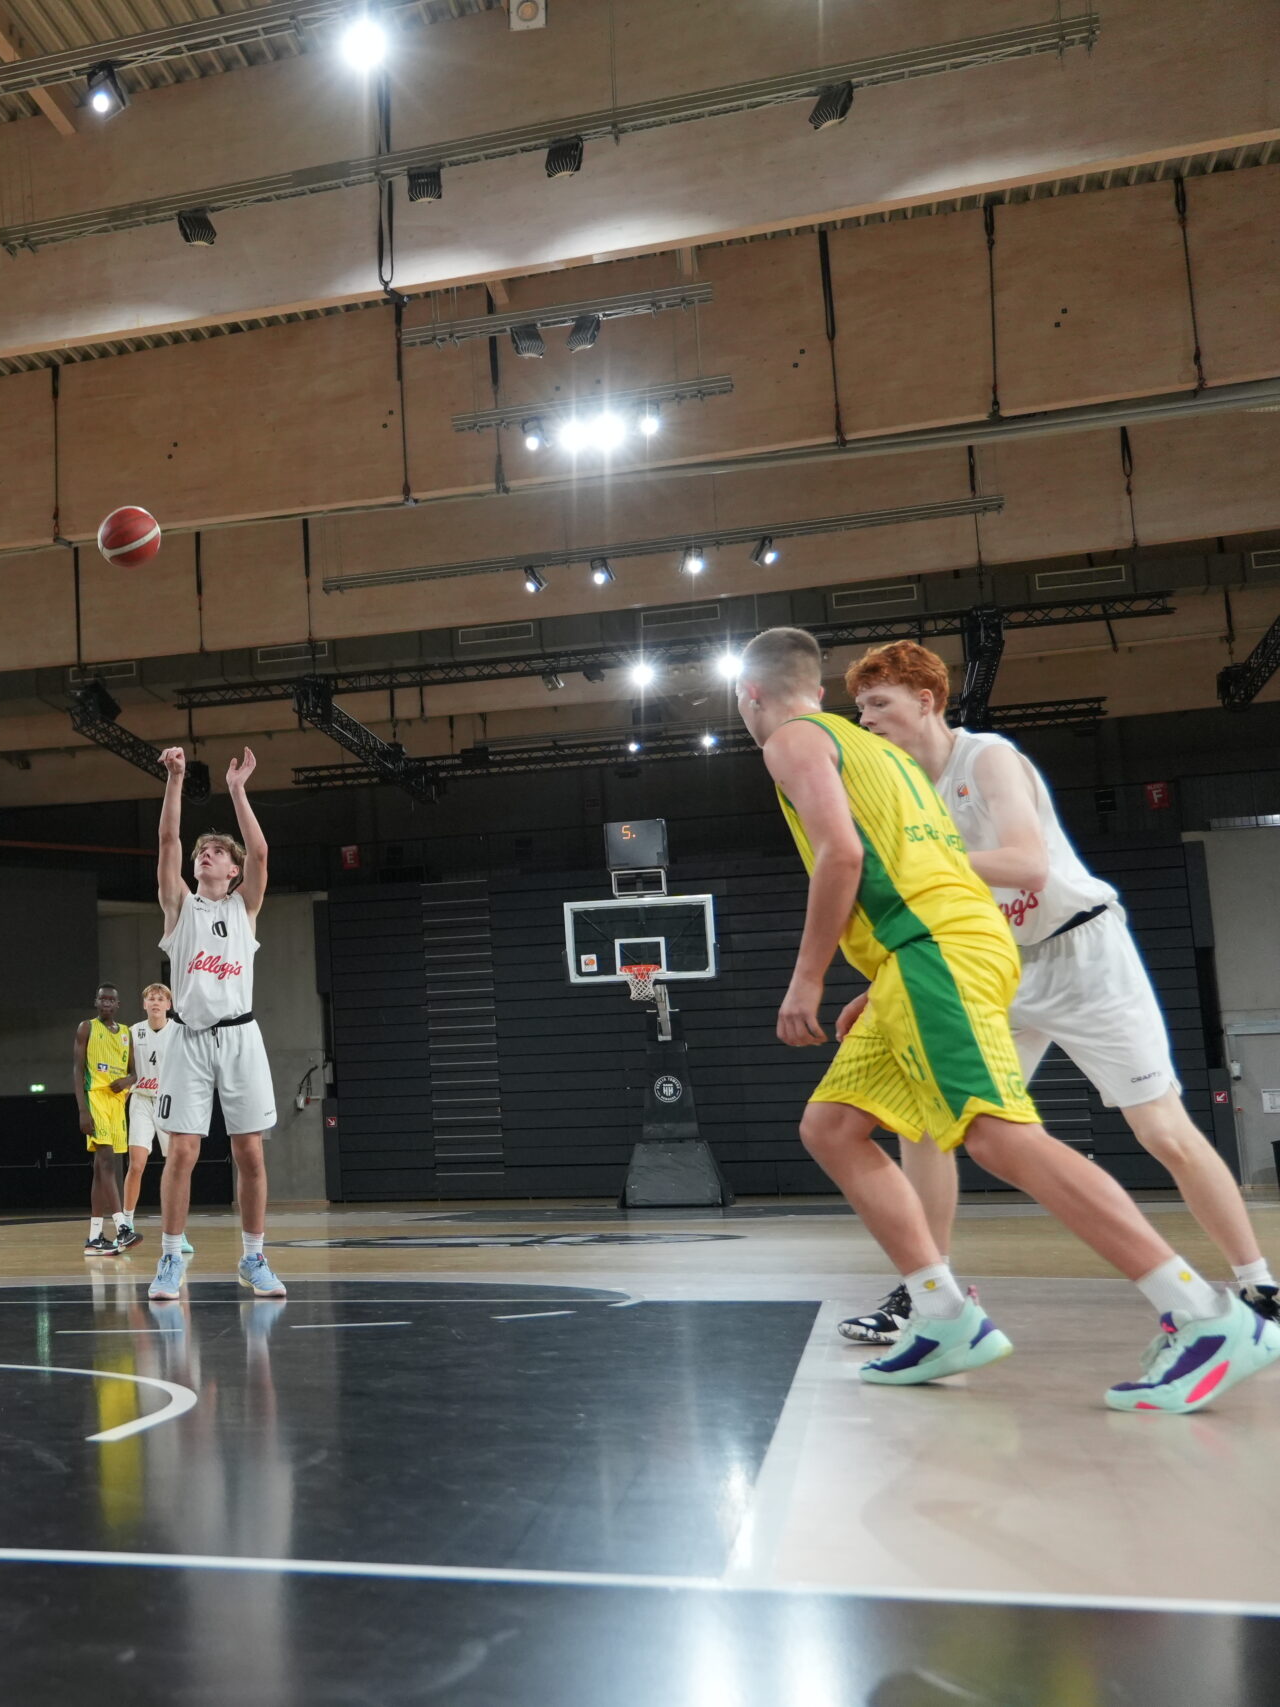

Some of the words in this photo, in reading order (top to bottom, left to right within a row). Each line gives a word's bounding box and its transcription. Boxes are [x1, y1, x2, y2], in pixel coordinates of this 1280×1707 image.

[1152, 789, 1163, 803] F
[149, 1050, 157, 1066] 4
[158, 1093, 172, 1120] 10
